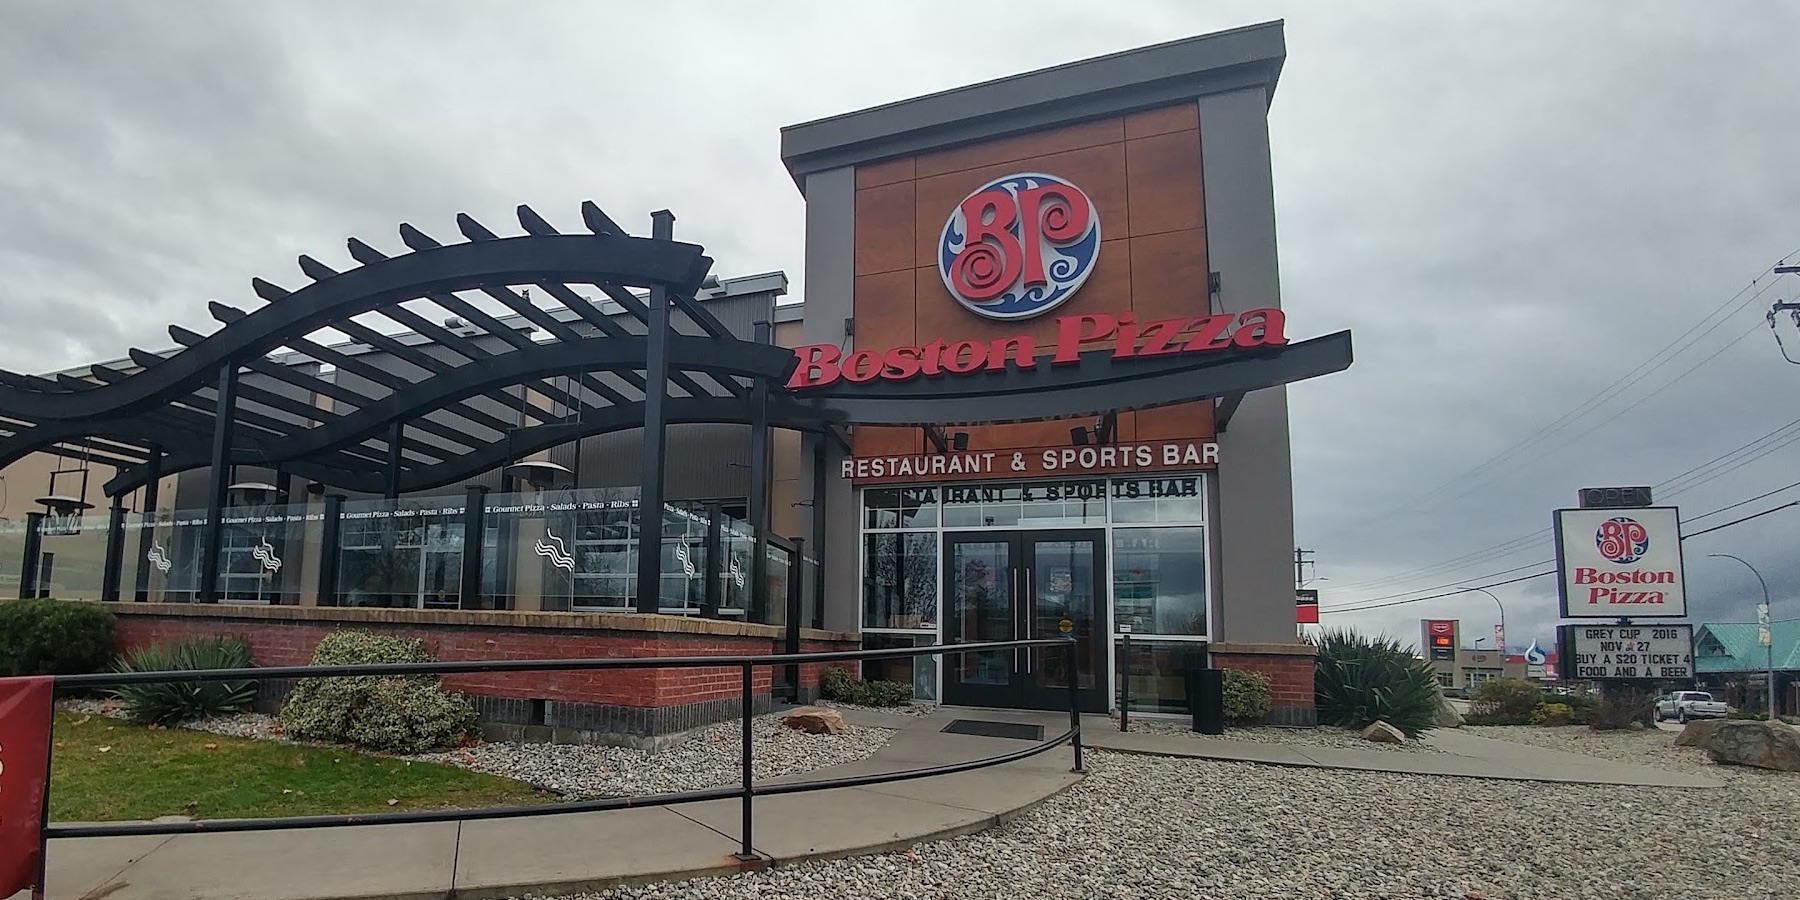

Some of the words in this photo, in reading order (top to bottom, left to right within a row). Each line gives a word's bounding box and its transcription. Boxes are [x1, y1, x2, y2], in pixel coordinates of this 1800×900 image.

[950, 183, 1091, 301] BP
[786, 335, 1038, 390] Boston
[1051, 308, 1289, 364] Pizza
[841, 452, 996, 479] RESTAURANT
[1010, 451, 1027, 472] &
[1042, 445, 1153, 470] SPORTS
[1162, 442, 1220, 466] BAR
[1586, 487, 1651, 503] OPEN
[393, 509, 415, 517] Salads
[419, 508, 437, 516] Pasta
[442, 507, 458, 515] Ribs
[492, 505, 524, 513] Gourmet
[525, 503, 545, 512] Pizza
[551, 502, 577, 511] Salads
[583, 501, 605, 509] Pasta
[611, 499, 630, 508] Ribs
[1600, 521, 1646, 559] BP
[1574, 567, 1675, 585] Boston
[1588, 587, 1664, 604] Pizza
[1586, 629, 1614, 639] GREY
[1619, 629, 1641, 639] CUP
[1652, 629, 1678, 639] 2016
[1601, 641, 1622, 652] NOV
[1637, 641, 1651, 652] 27
[1576, 653, 1597, 664] BUY
[1603, 654, 1611, 664] A
[1641, 653, 1679, 664] TICKET
[1683, 653, 1690, 664] 4
[1579, 666, 1607, 677] FOOD
[1614, 666, 1637, 677] AND
[1645, 666, 1653, 677] A
[1661, 666, 1688, 677] BEER
